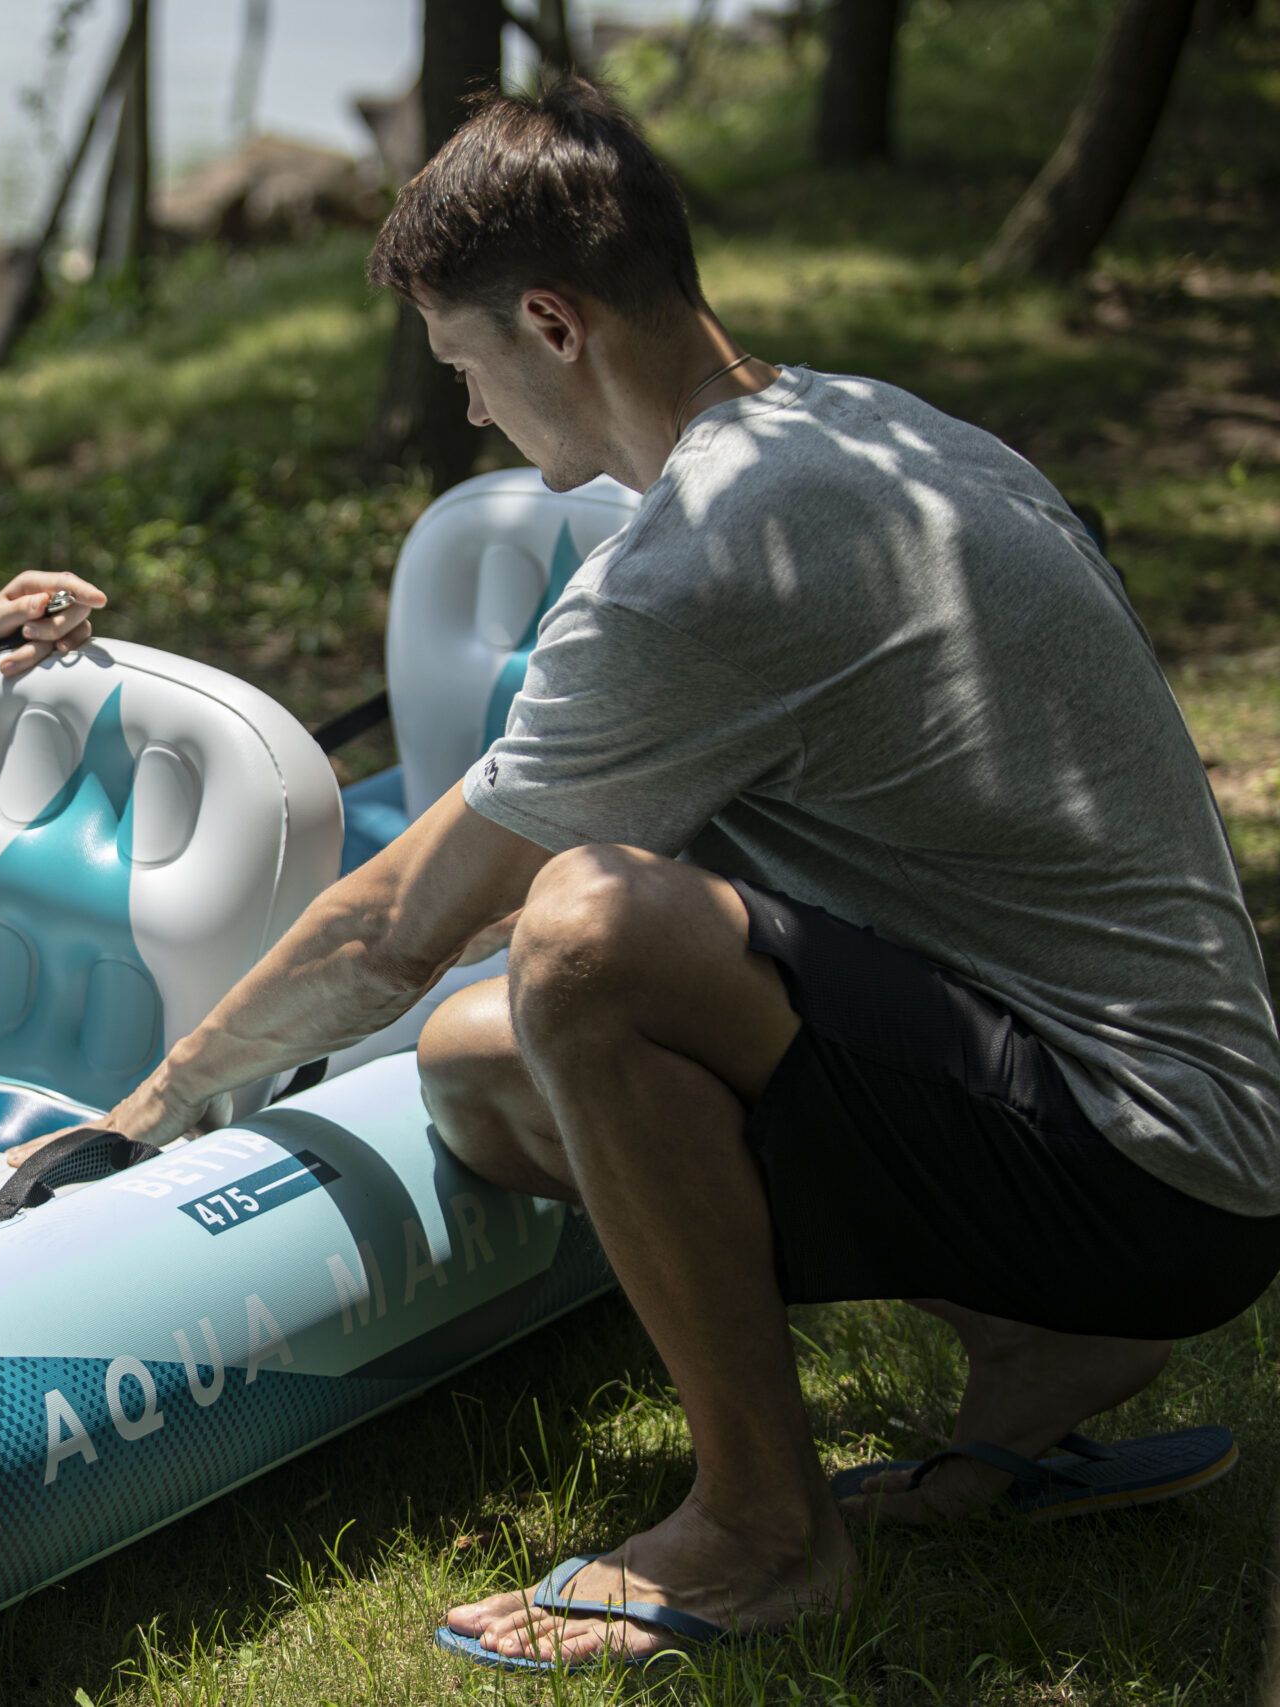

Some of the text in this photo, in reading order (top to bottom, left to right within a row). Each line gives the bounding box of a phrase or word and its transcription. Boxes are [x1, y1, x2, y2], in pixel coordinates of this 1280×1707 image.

[110, 1133, 286, 1199] BETTA
[193, 1186, 260, 1227] 475
[43, 1293, 295, 1486] AQUA
